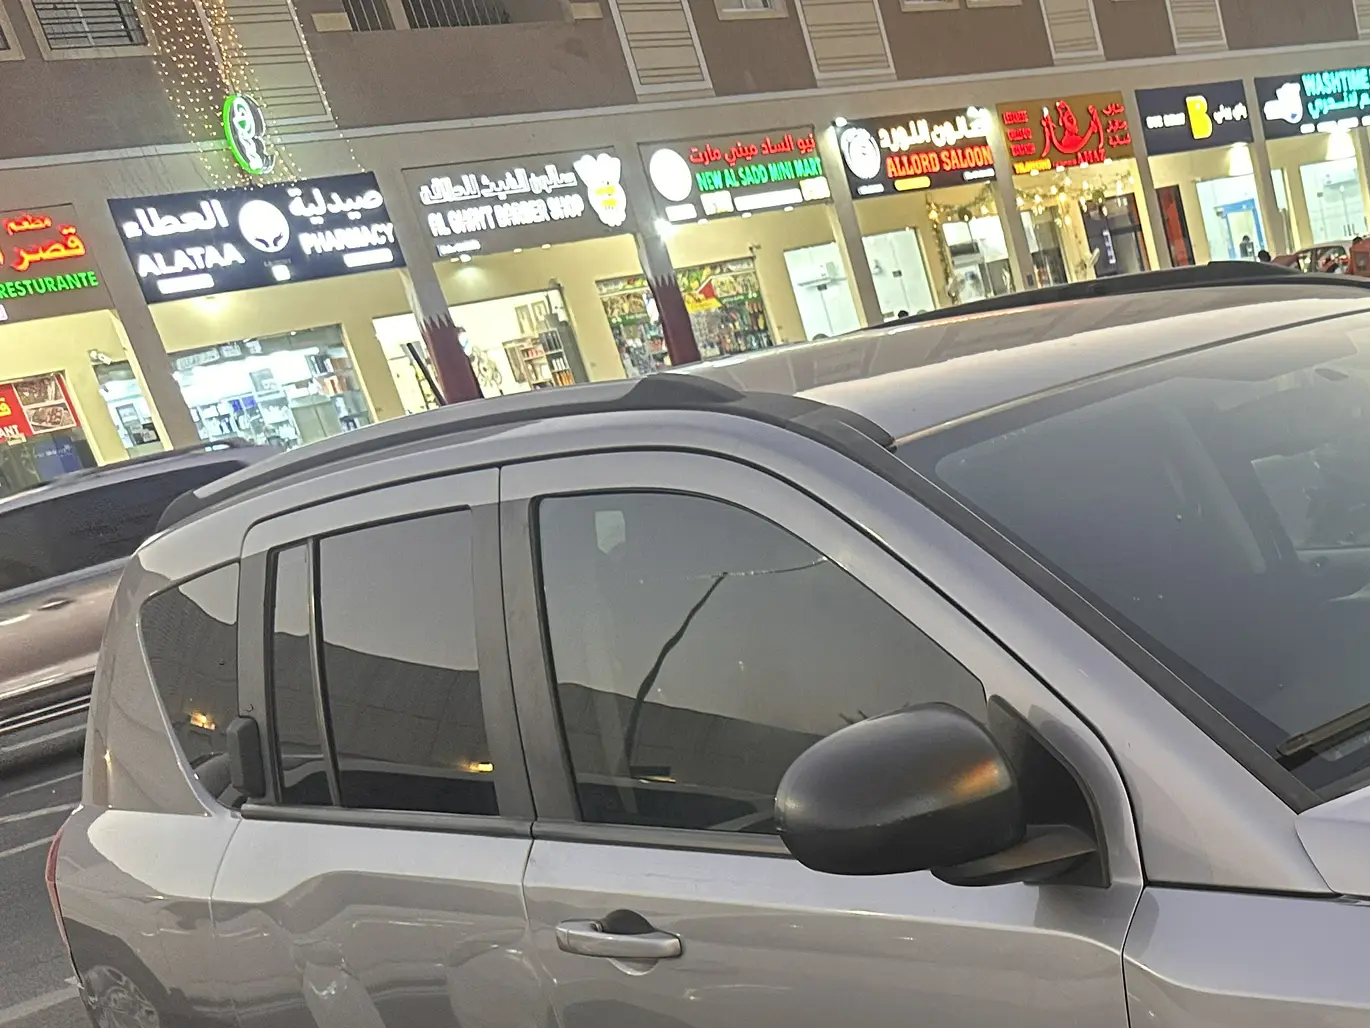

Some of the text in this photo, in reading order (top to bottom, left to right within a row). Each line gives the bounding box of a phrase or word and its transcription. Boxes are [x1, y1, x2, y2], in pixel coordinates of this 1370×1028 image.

[689, 144, 722, 165] مارت
[885, 151, 940, 178] ALLORD
[939, 145, 994, 171] SALOON
[695, 156, 823, 191] NEW AL SADD MINI MART
[3, 213, 52, 236] مطعم
[122, 187, 384, 239] صيدلية العطاء
[428, 212, 451, 237] AL
[11, 225, 86, 272] قصر
[136, 243, 246, 277] ALATAA
[299, 222, 397, 255] PHARMACY
[0, 271, 99, 299] RESTURANTE
